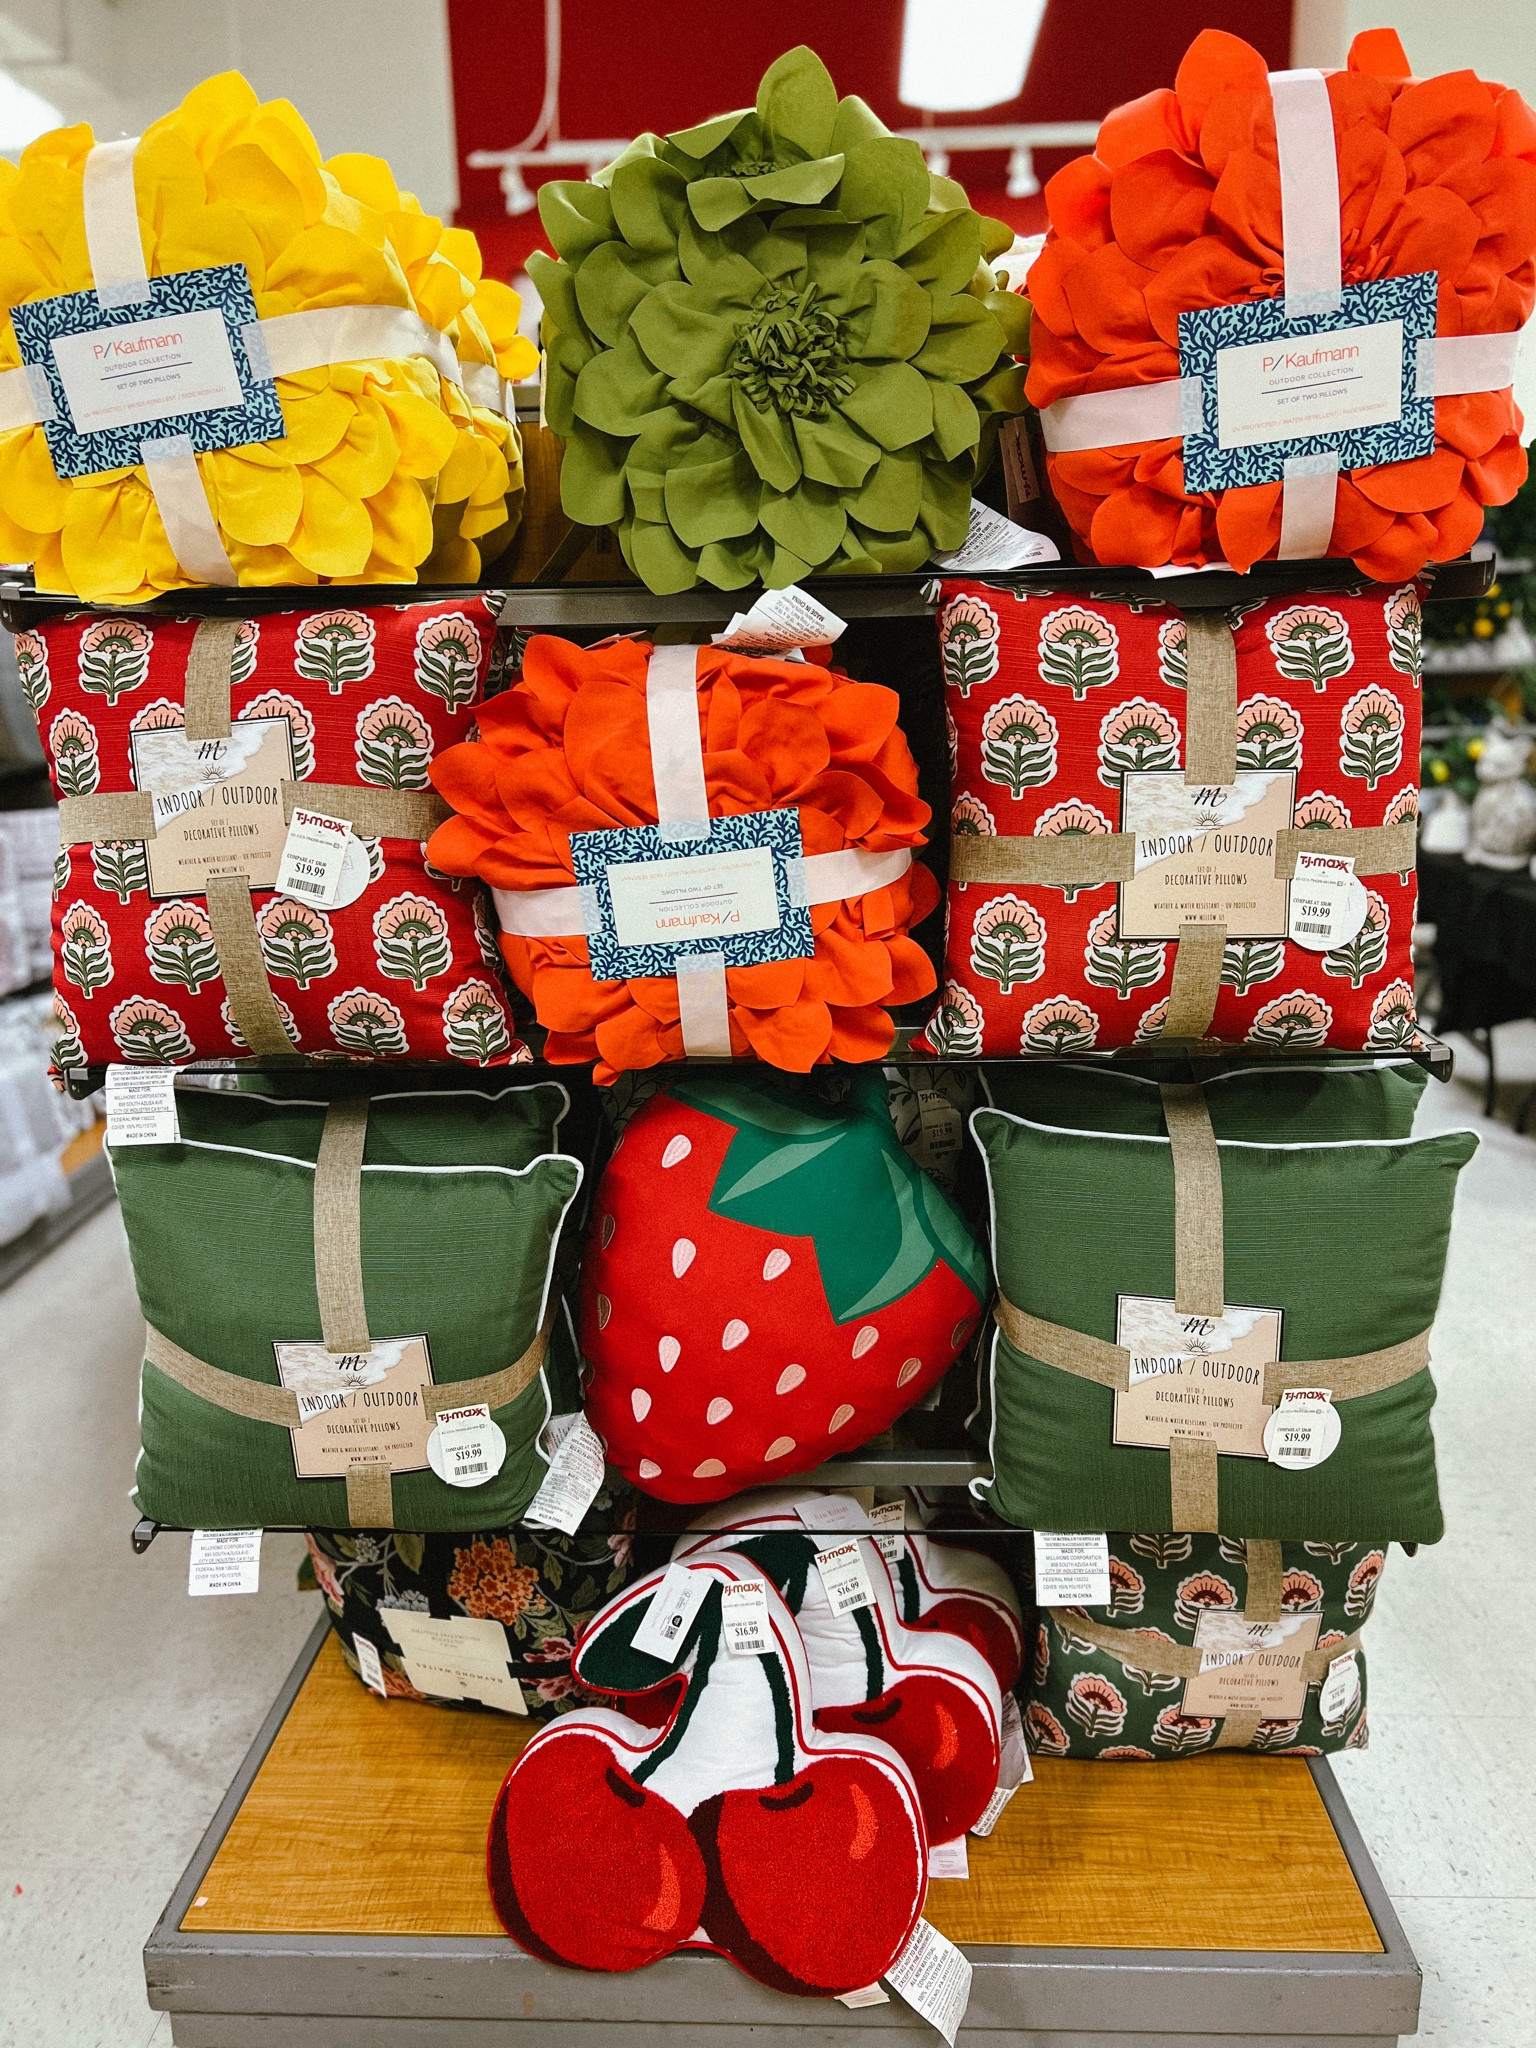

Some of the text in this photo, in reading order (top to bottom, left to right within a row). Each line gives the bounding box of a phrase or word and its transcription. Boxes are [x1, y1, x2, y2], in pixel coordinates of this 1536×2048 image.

[104, 353, 182, 372] OUTDOOR COLLECTION
[1262, 345, 1359, 373] P/Kaufmann
[116, 382, 128, 391] SET
[138, 378, 153, 386] TWO
[153, 372, 181, 383] PILLOWS
[1269, 367, 1354, 386] OUTDOOR COLLECTION
[1277, 397, 1289, 405] SET
[1302, 392, 1318, 401] TWO
[1319, 388, 1348, 398] PILLOWS
[810, 608, 825, 622] MADE
[157, 789, 205, 816] INDOOR
[222, 786, 278, 805] OUTDOOR
[183, 824, 259, 841] DECORATIVE PILLOWS
[1141, 835, 1193, 857] INDOOR
[1214, 834, 1273, 856] OUTDOOR
[295, 862, 325, 878] $19.99
[1165, 874, 1247, 885] DECORATIVE PILLOWS
[661, 888, 687, 896] PILLOWS
[658, 898, 733, 913] OUTDOOR COLLECTION
[1301, 905, 1331, 918] $19.99
[932, 1127, 952, 1138] $19.99
[1134, 1357, 1183, 1375] INDOOR
[1202, 1360, 1260, 1386] OUTDOOR
[300, 1394, 347, 1412] INDOOR
[364, 1391, 419, 1407] OUTDOOR
[1155, 1391, 1234, 1408] DECORATIVE PILLOWS
[327, 1421, 400, 1434] DECORATIVE PILLOWS
[1220, 1422, 1243, 1430] PROTECTED
[1284, 1433, 1311, 1442] $19.99
[456, 1448, 482, 1461] $19.99
[837, 1581, 859, 1596] $16.99
[735, 1626, 759, 1636] $16.99
[1206, 1653, 1243, 1666] INDOOR
[1258, 1653, 1301, 1668] OUTDOOR
[1219, 1677, 1279, 1686] DECORATIVE PILLOWS
[916, 1922, 929, 1943] REMOVED
[898, 1969, 910, 1988] EXCEPT
[917, 1931, 933, 1956] CONSUMER
[920, 1947, 936, 1969] MATERIAL
[917, 1962, 935, 1988] CONSISTING
[925, 1963, 942, 1990] POLYESTER
